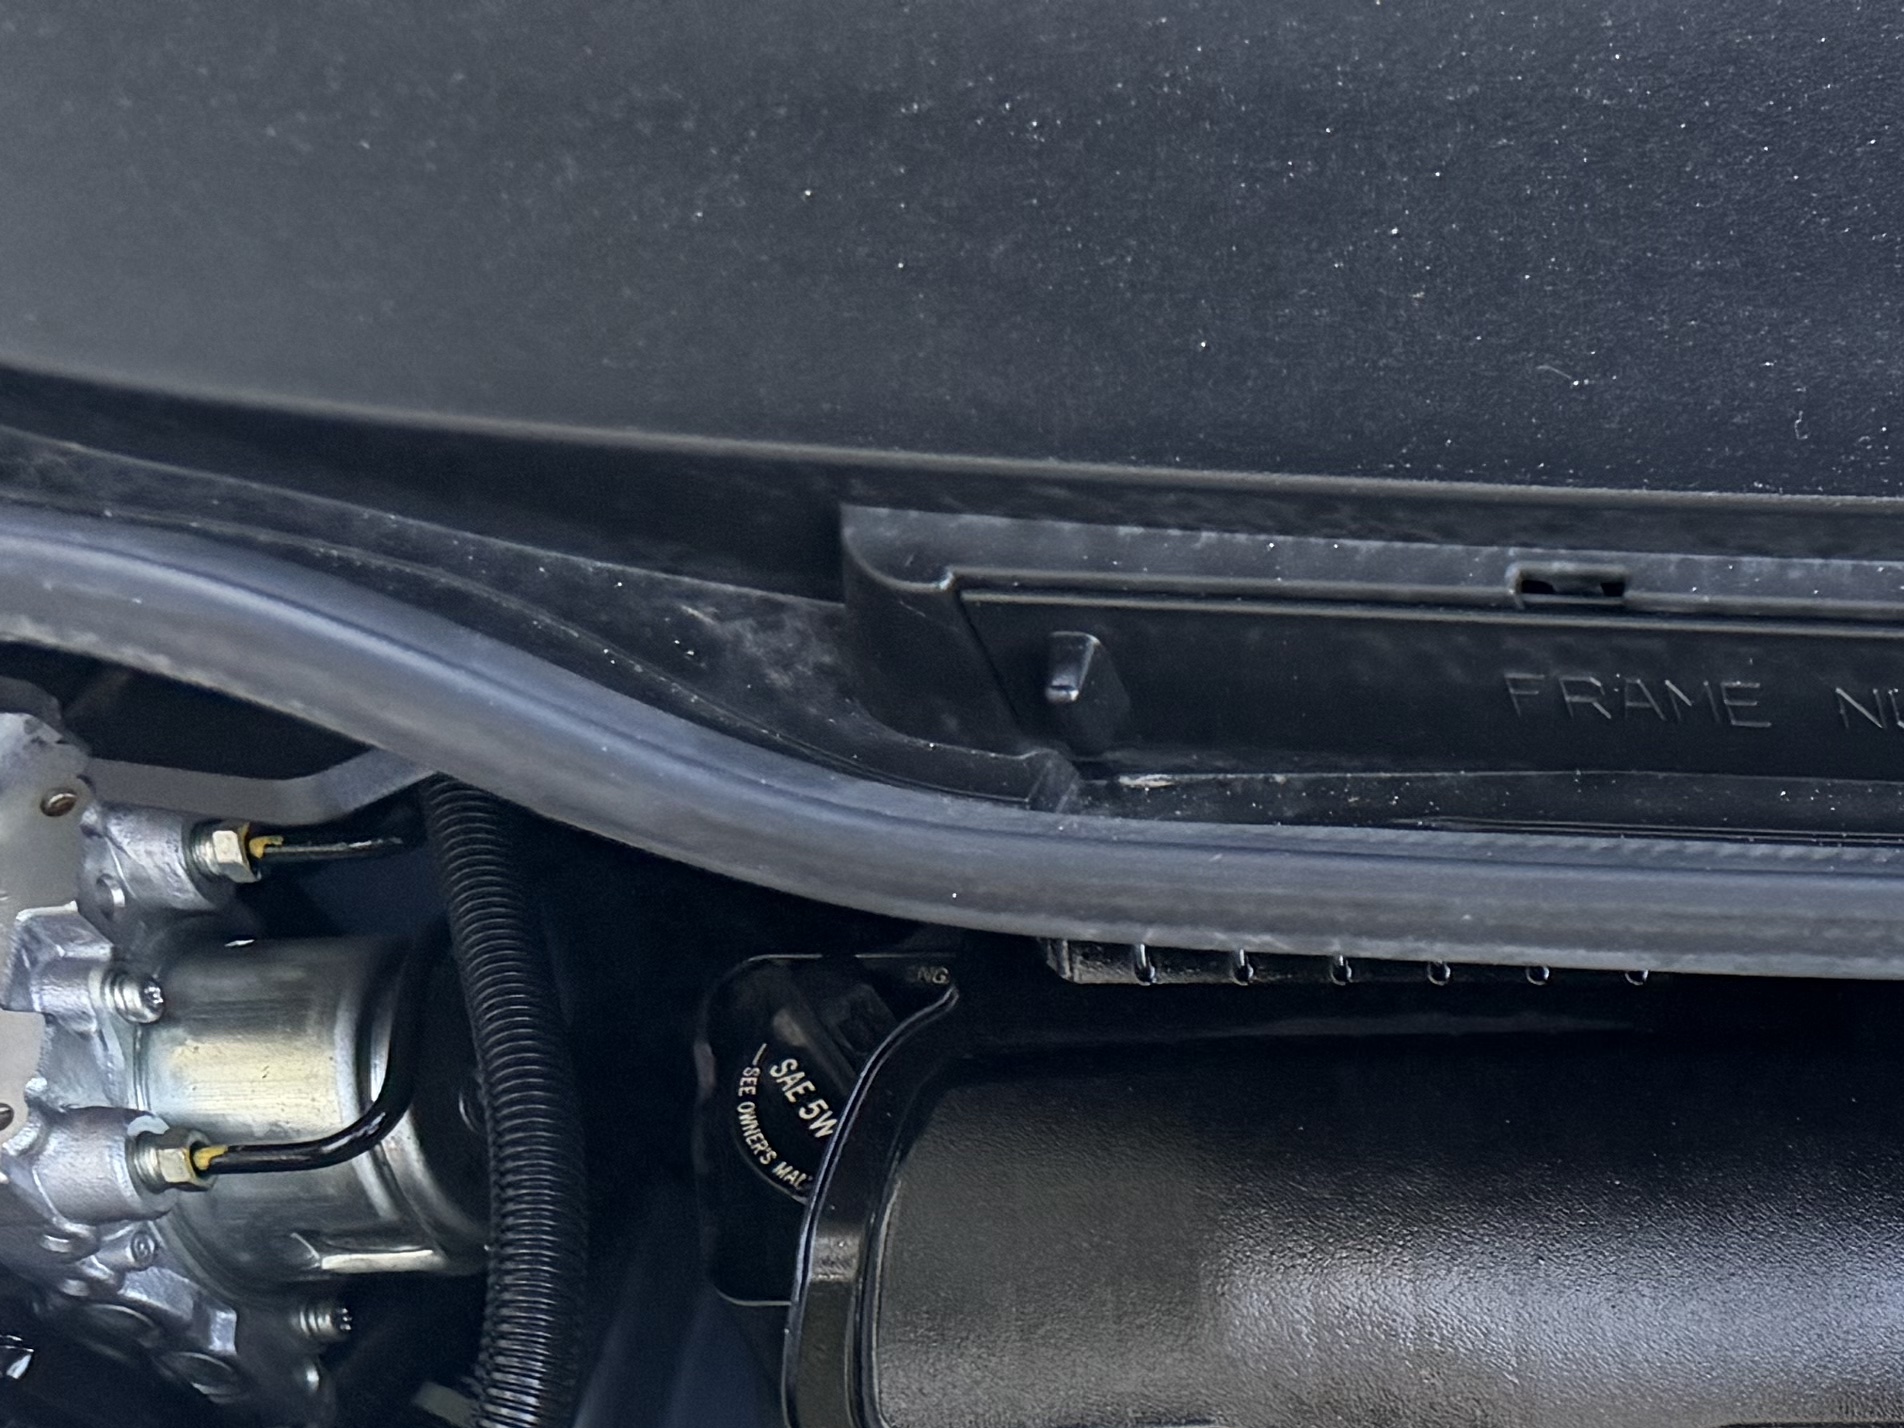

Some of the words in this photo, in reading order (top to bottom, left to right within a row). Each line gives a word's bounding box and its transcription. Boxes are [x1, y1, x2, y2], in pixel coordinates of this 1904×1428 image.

[1504, 674, 1771, 728] FRAME
[738, 1066, 761, 1097] SEE
[770, 1058, 817, 1103] SAE
[737, 1101, 777, 1165] OWNER'S
